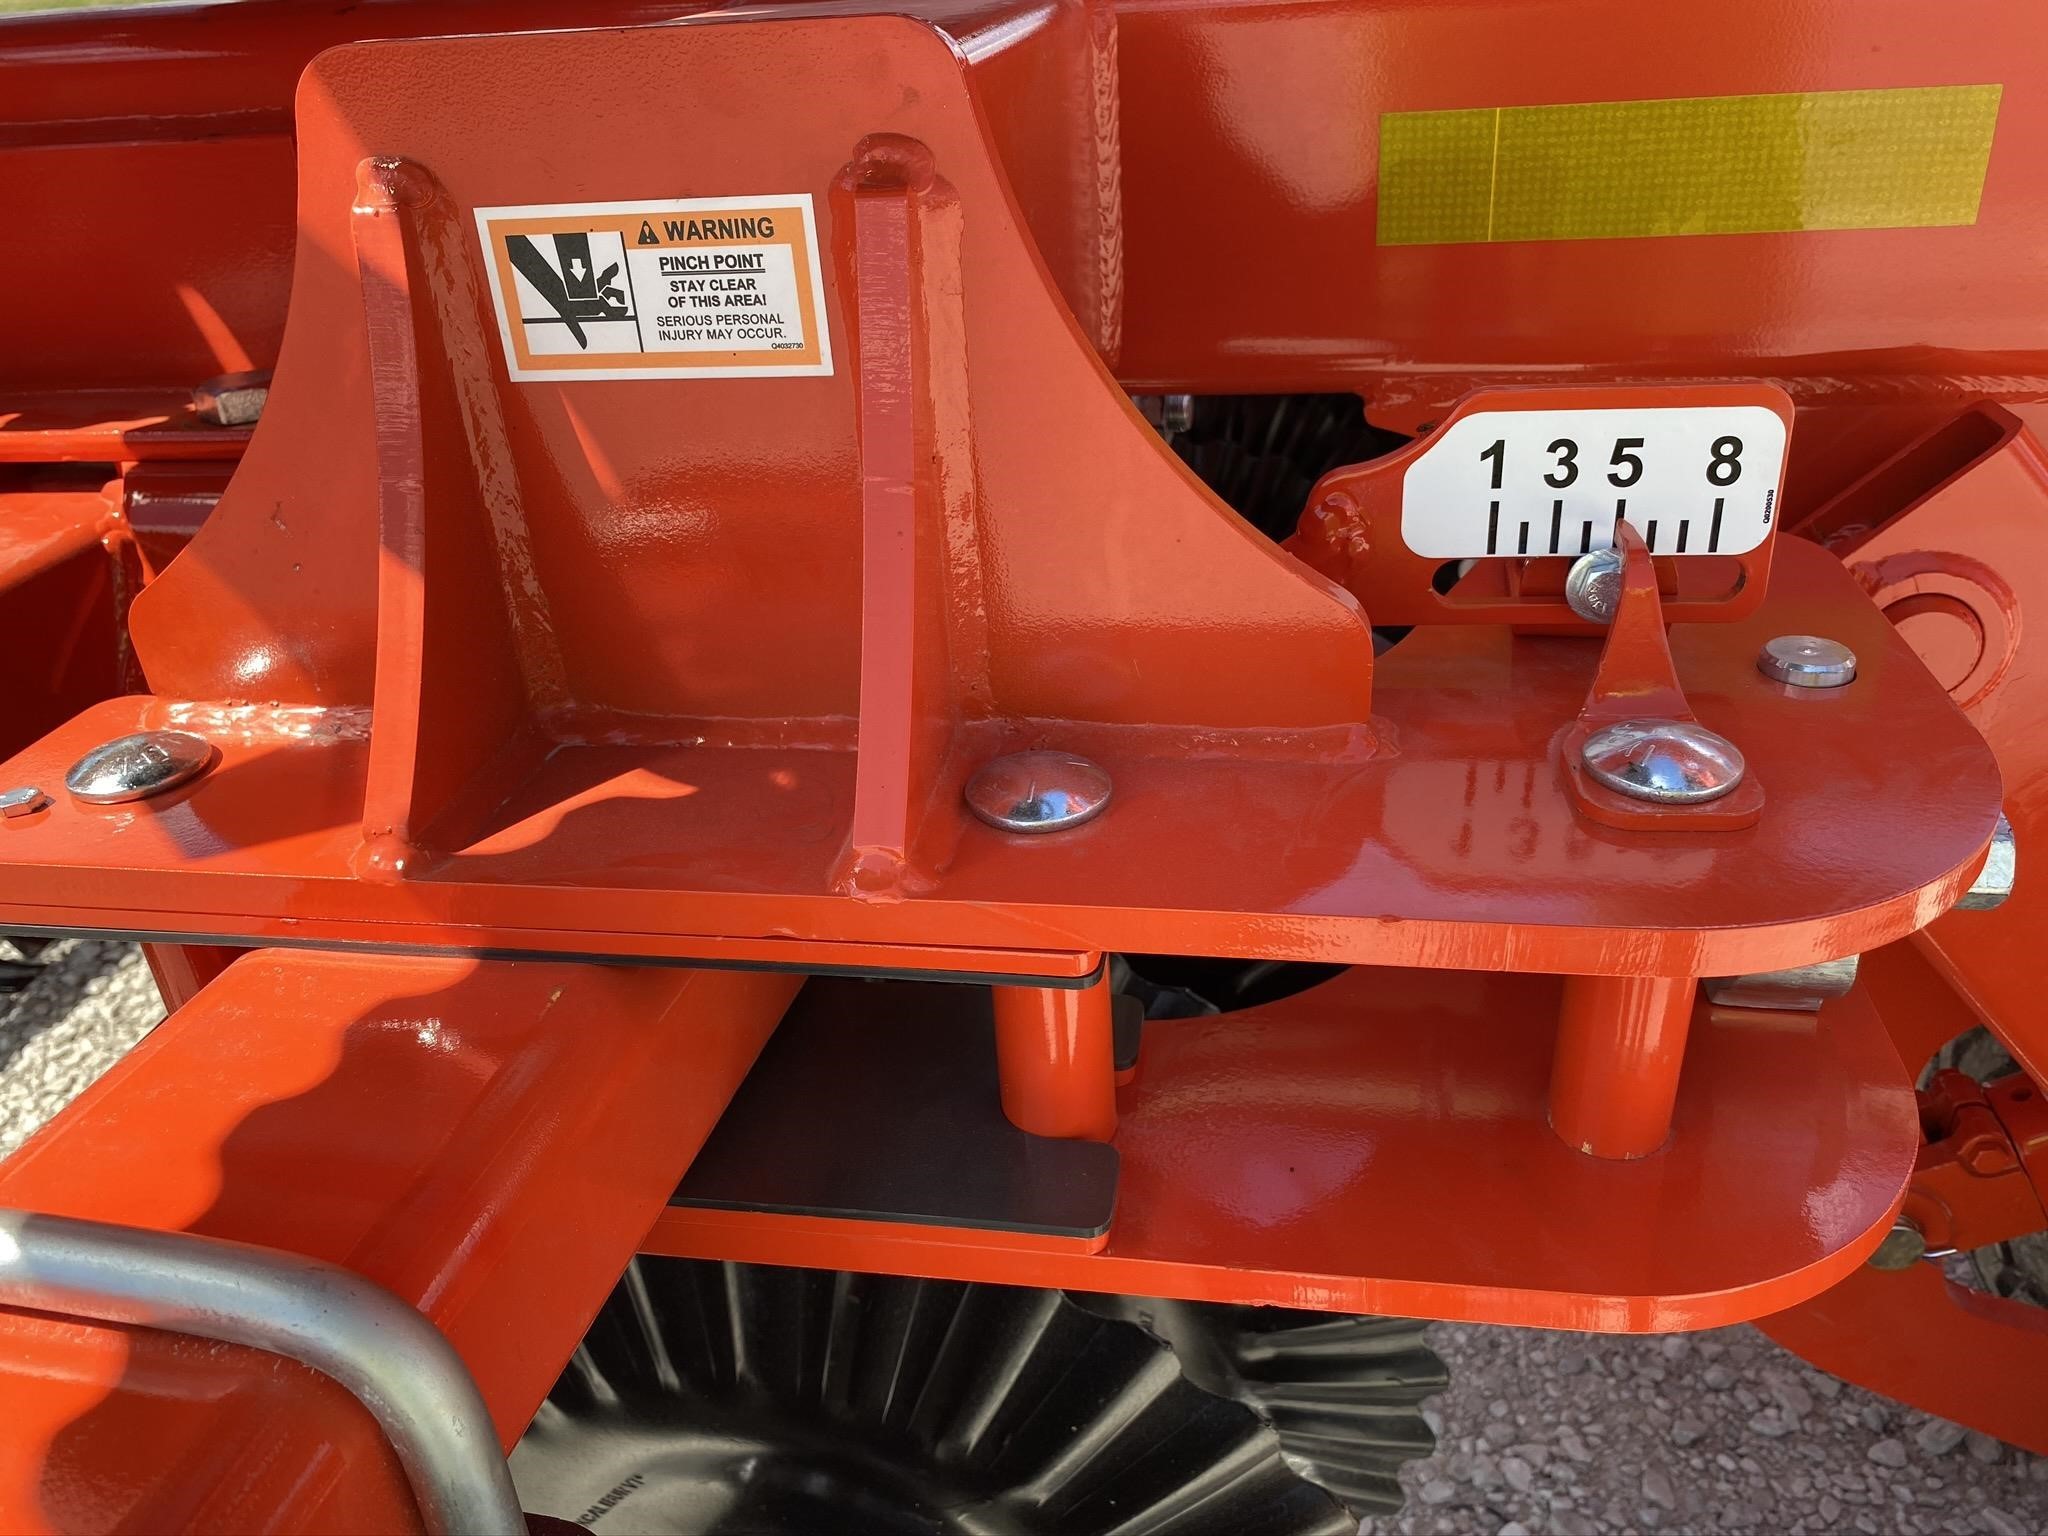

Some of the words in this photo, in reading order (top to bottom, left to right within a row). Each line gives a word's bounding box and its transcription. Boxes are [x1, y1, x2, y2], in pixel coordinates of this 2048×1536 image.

[663, 217, 775, 241] WARNING
[659, 255, 710, 271] PINCH
[713, 254, 763, 269] POINT
[670, 280, 705, 292] STAY
[709, 278, 757, 291] CLEAR
[668, 296, 686, 308] OF
[690, 295, 721, 307] THIS
[724, 294, 767, 307] AREA!
[656, 315, 713, 327] SERIOUS
[716, 313, 784, 325] PERSONAL
[658, 330, 704, 341] INJURY
[706, 329, 733, 340] MAY
[737, 328, 787, 340] OCCUR.
[771, 342, 804, 350] Q4032730
[1481, 440, 1505, 489] 1
[1544, 439, 1578, 488] 3
[1608, 438, 1644, 487] 5
[1706, 436, 1743, 486] 8
